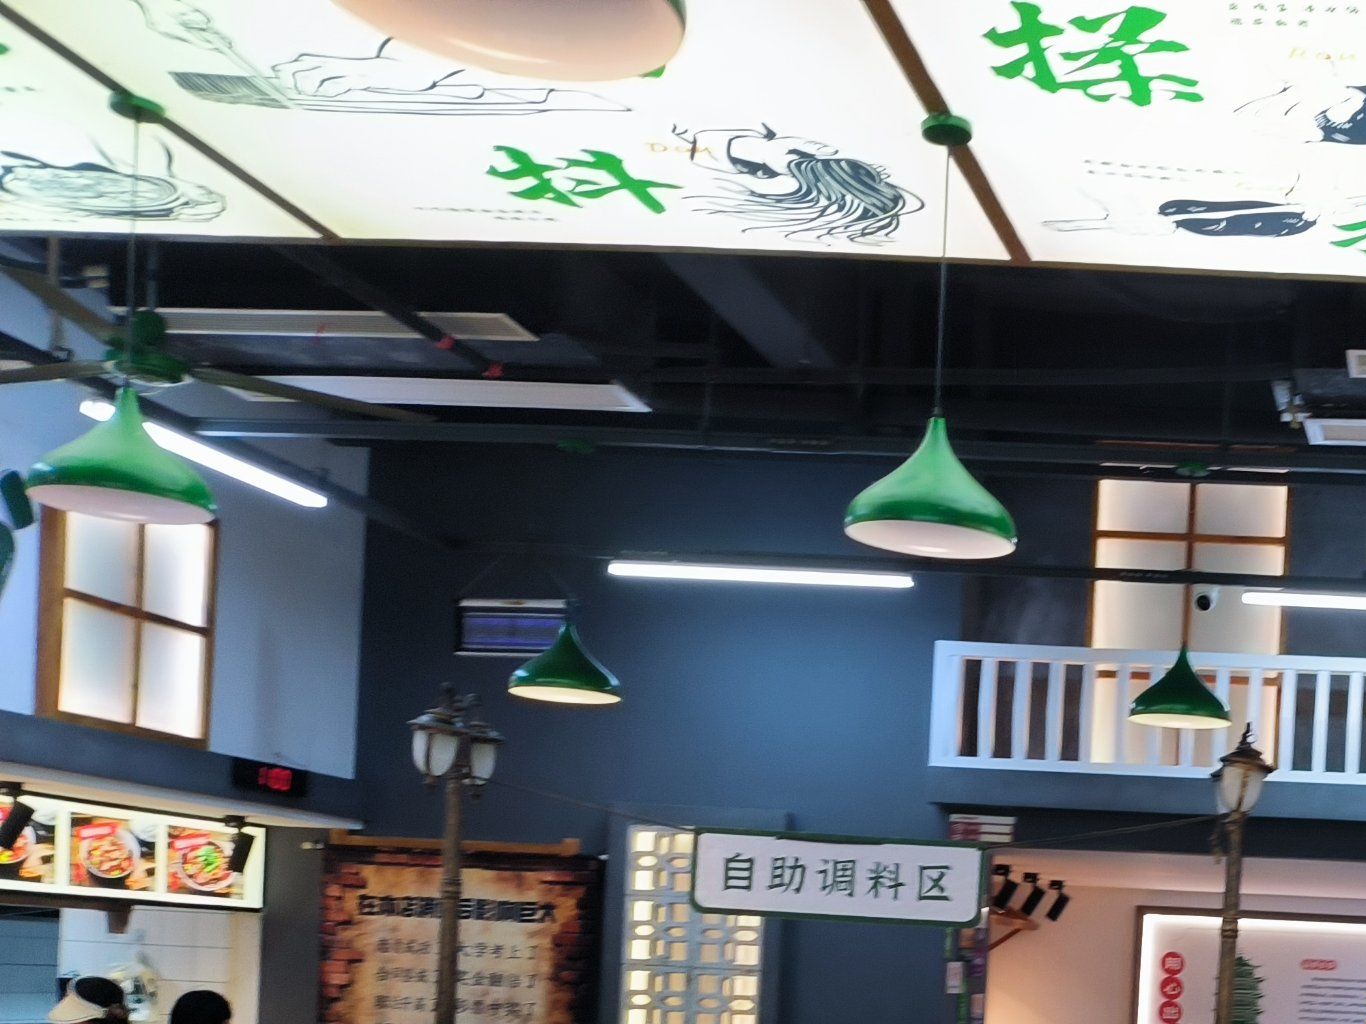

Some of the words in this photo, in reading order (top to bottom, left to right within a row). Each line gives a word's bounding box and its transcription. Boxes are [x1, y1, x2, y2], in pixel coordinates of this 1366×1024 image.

[982, 2, 1204, 107] 揉
[723, 851, 953, 902] 自助调料区
